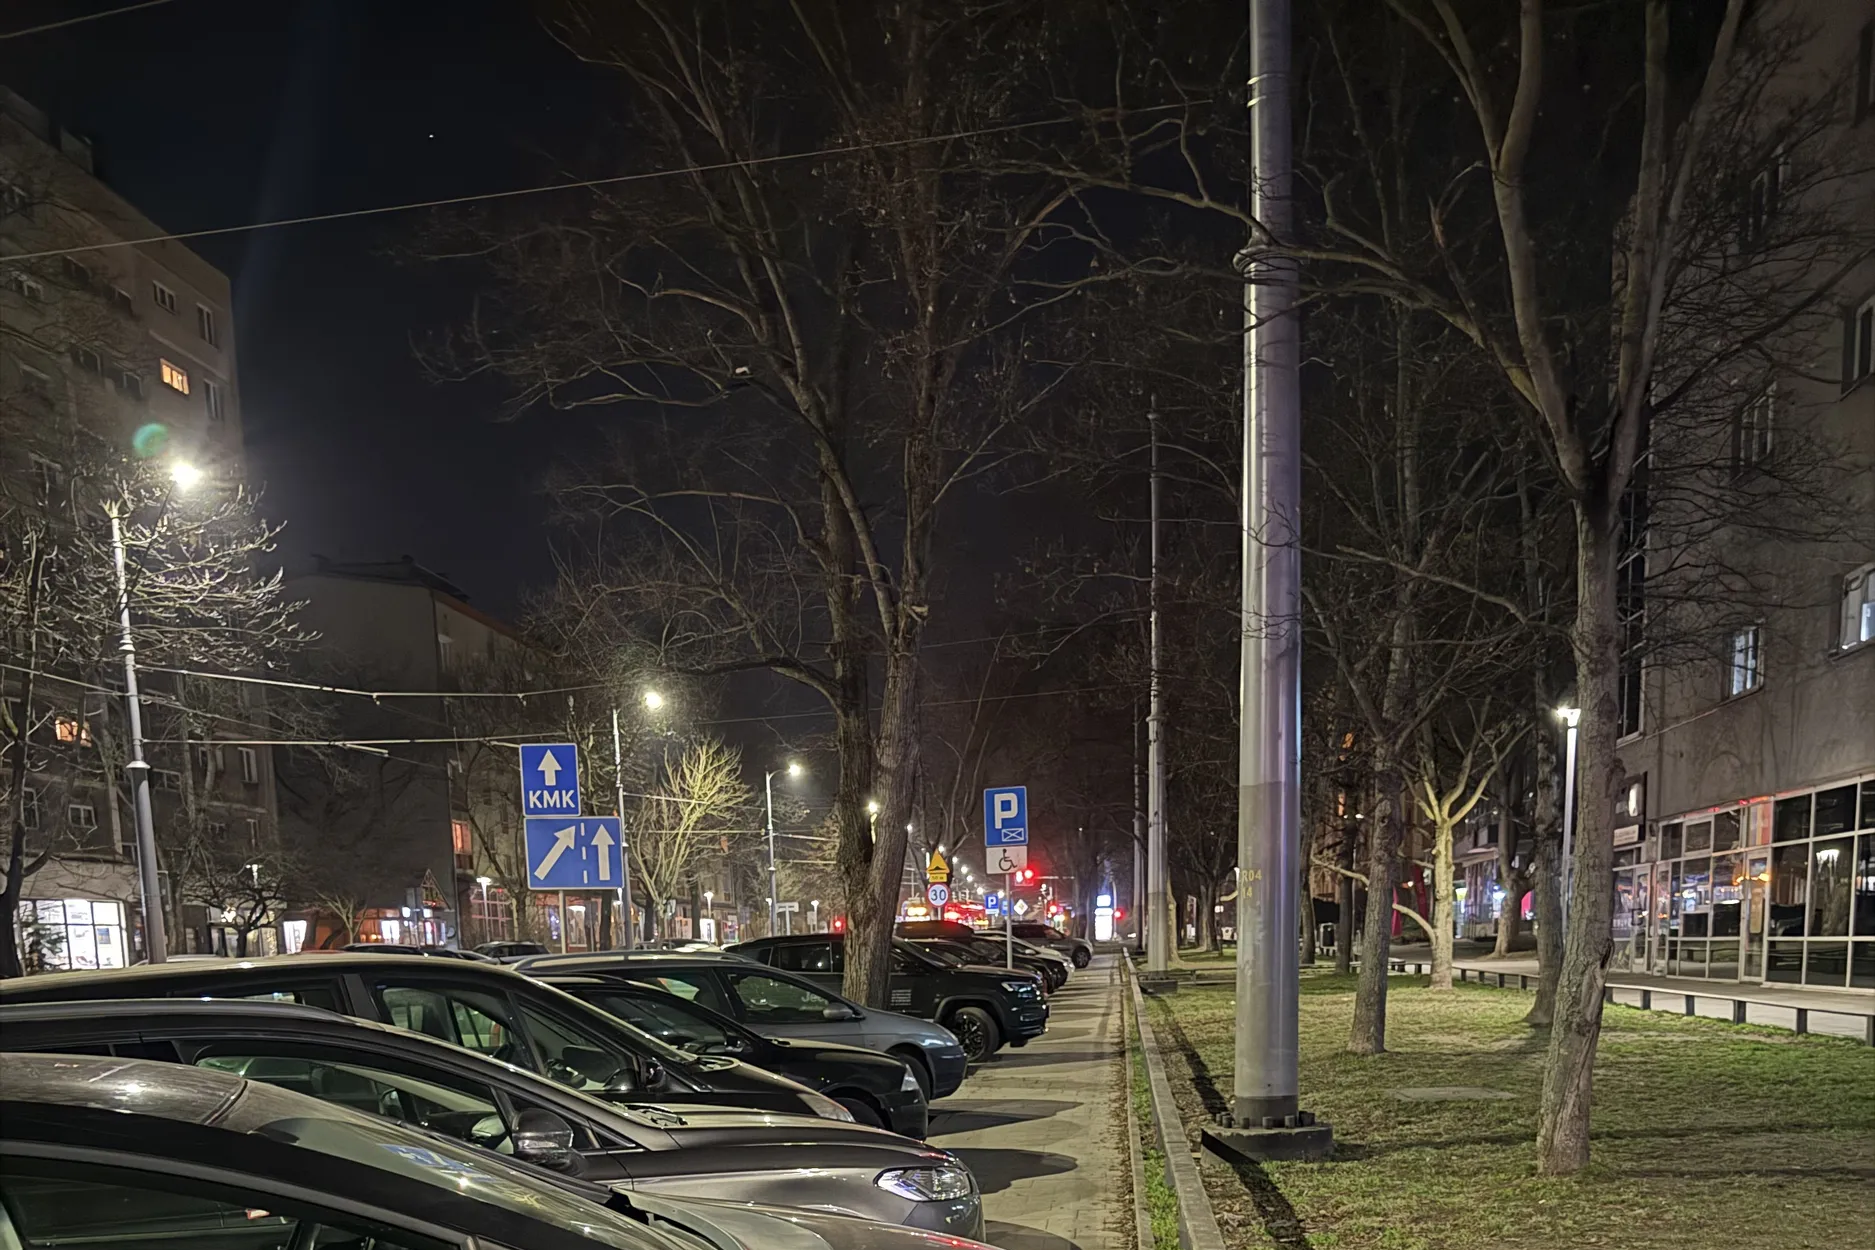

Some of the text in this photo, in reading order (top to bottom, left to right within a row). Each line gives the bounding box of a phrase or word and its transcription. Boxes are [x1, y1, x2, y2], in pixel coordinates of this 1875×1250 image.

[528, 789, 576, 809] KMK
[993, 792, 1018, 829] P
[931, 889, 946, 901] 30
